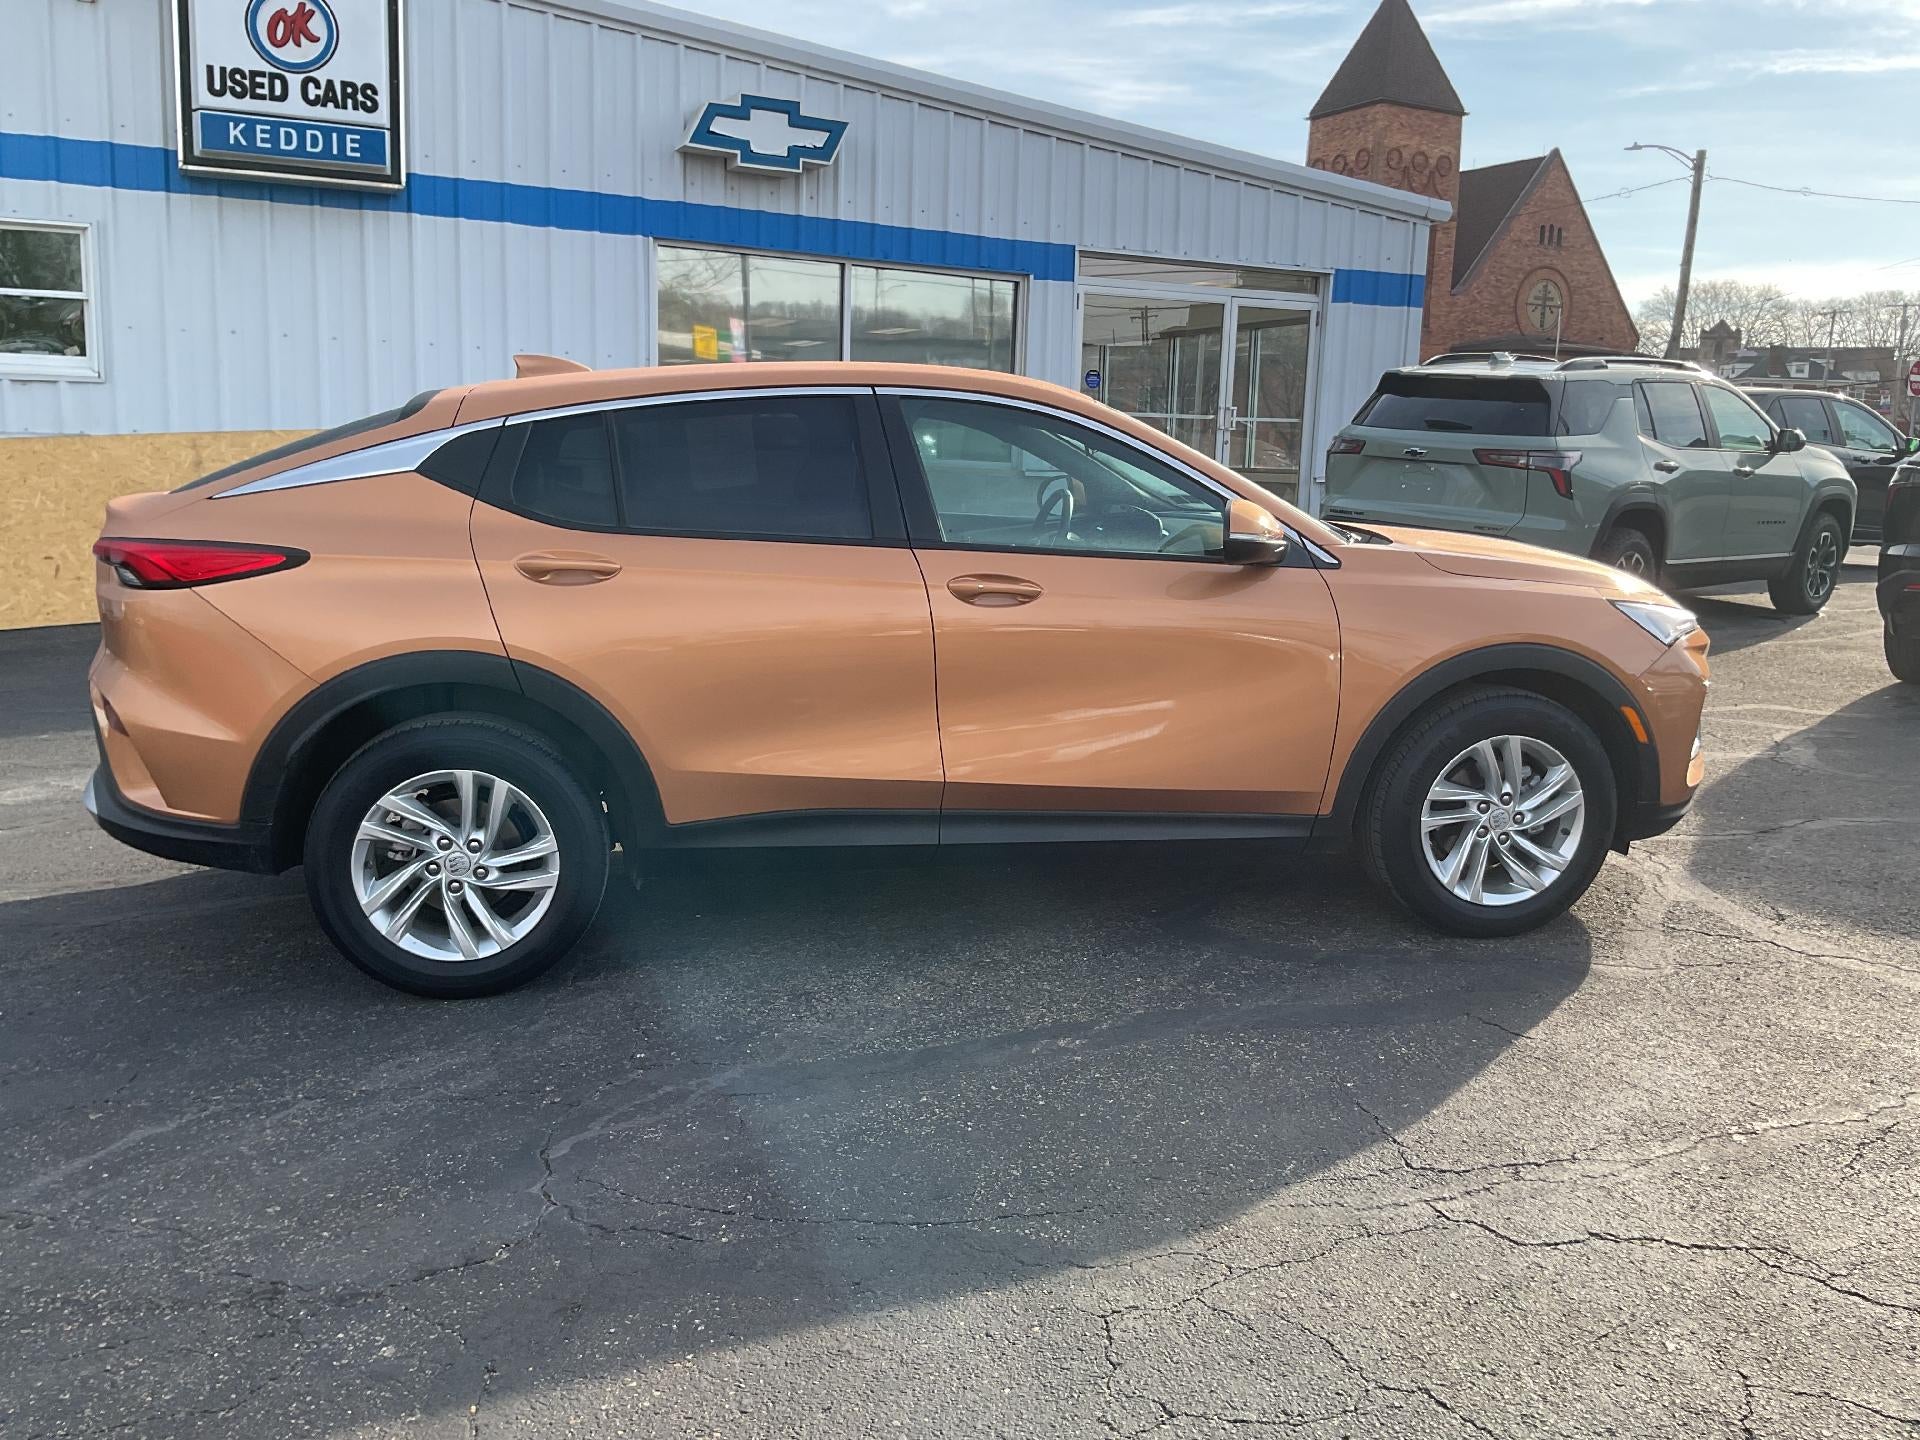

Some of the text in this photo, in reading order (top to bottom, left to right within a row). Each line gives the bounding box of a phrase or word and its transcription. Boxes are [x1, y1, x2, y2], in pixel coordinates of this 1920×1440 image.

[267, 3, 320, 48] OK
[206, 65, 379, 113] USED CARS
[229, 122, 361, 157] KEDDIE
